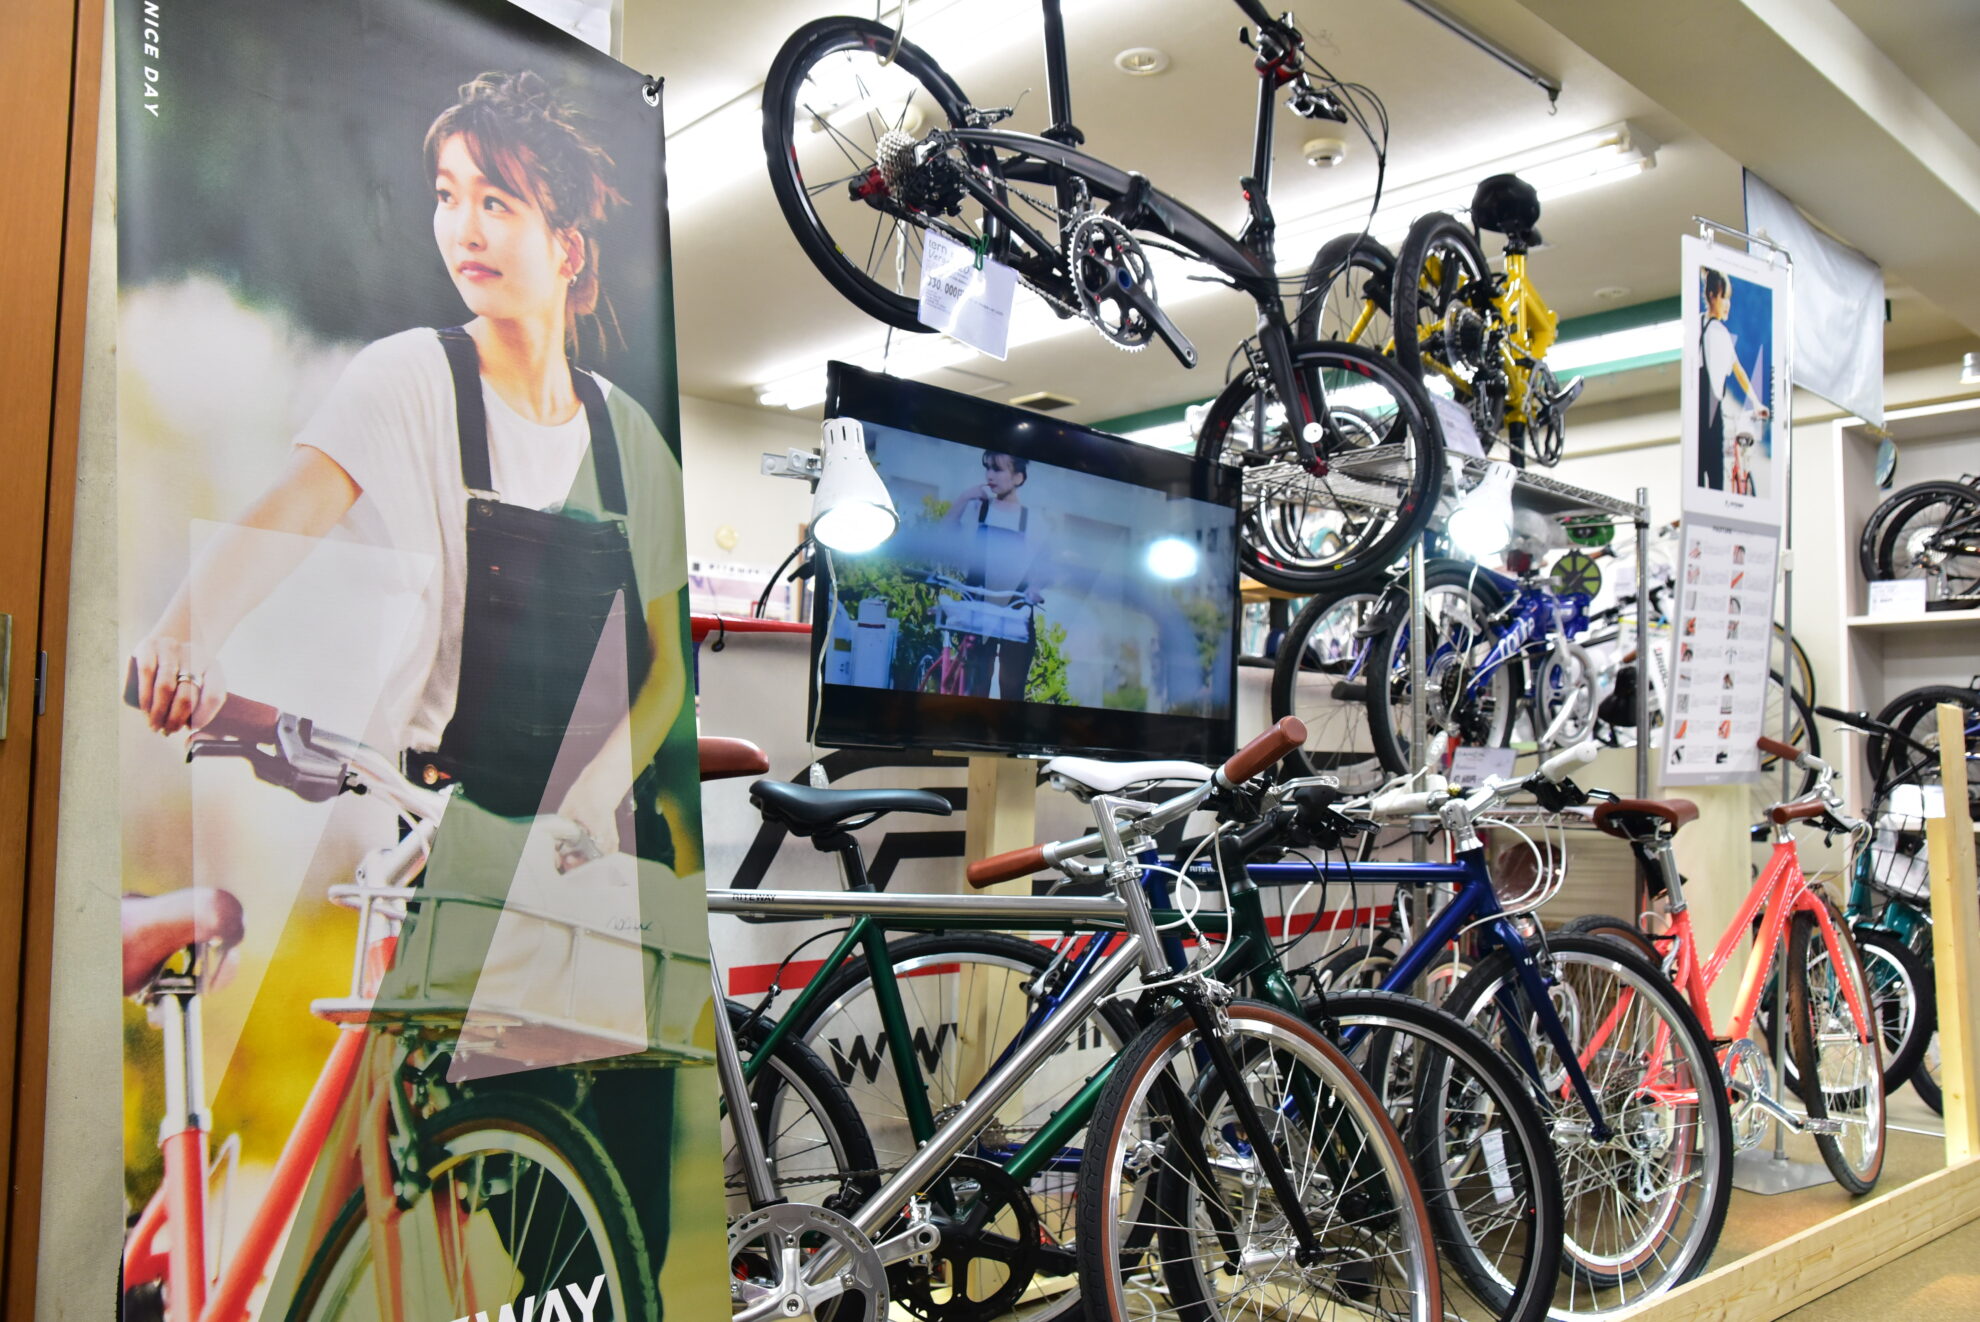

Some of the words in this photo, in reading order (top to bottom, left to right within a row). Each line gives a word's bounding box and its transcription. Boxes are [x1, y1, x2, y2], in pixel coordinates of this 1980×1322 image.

[143, 0, 160, 59] NICE
[143, 65, 159, 118] DAY
[732, 893, 776, 901] RITEWAY
